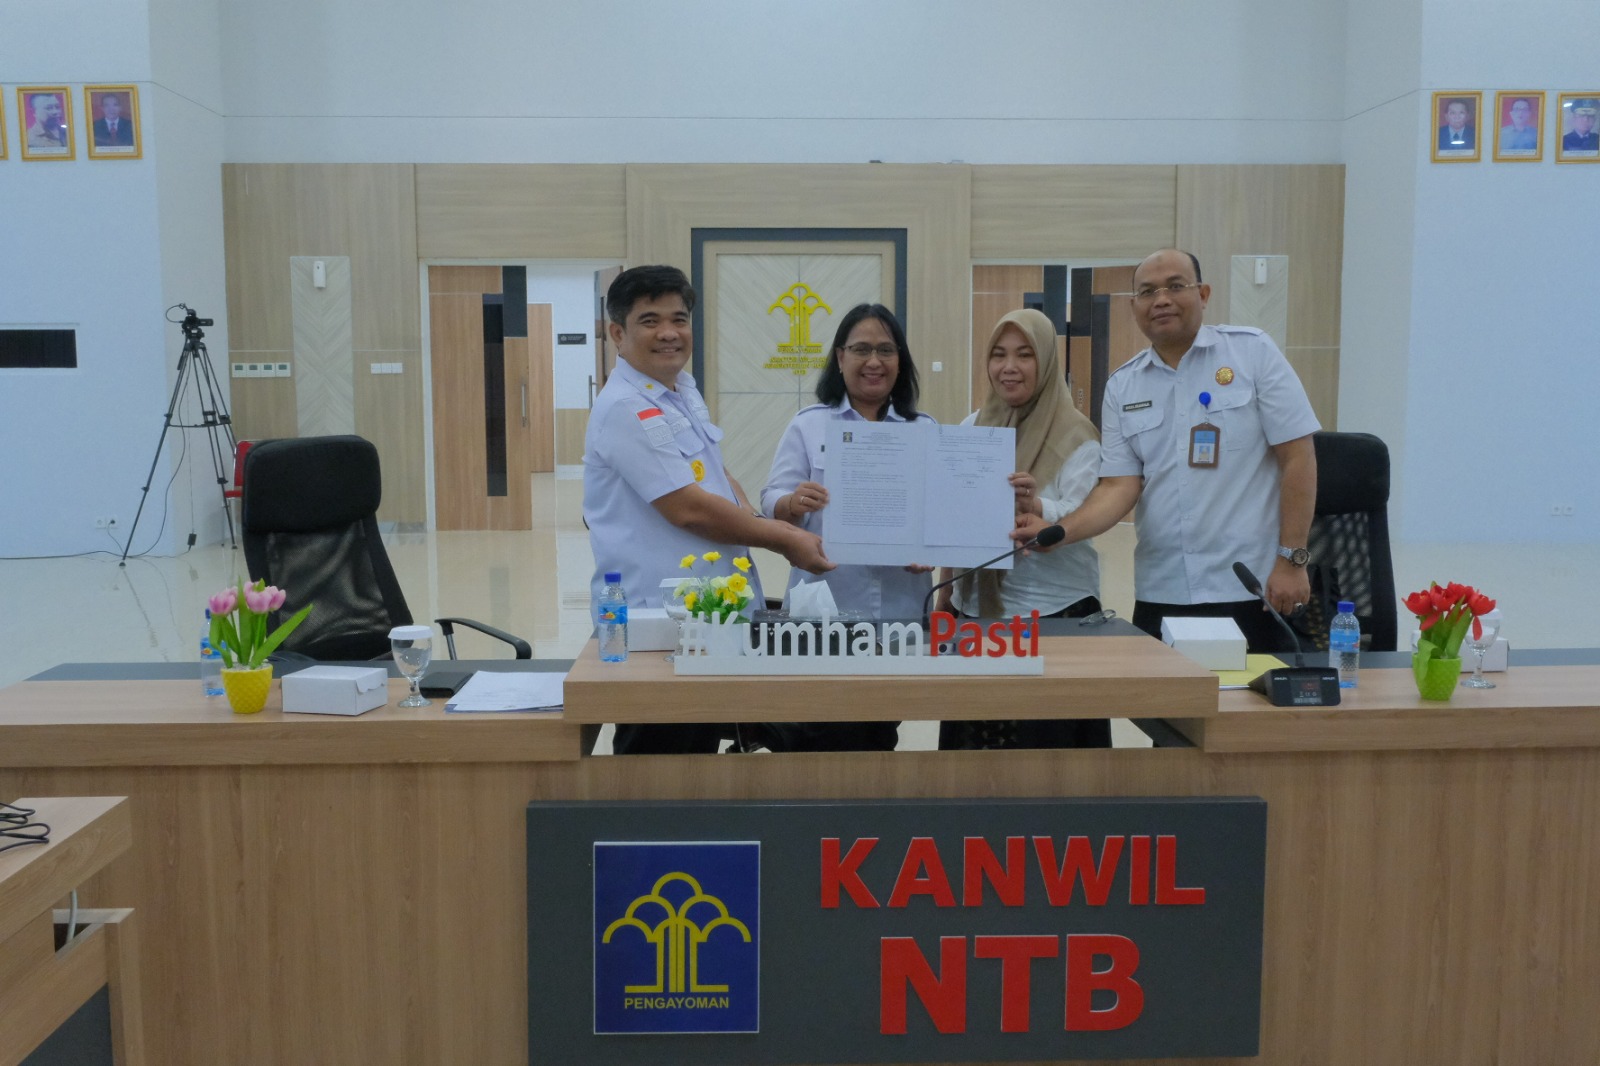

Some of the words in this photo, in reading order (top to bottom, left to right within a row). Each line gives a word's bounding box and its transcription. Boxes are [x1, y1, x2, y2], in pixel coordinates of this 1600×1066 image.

[820, 835, 1206, 909] KANWIL
[624, 997, 730, 1010] PENGAYOMAN
[880, 934, 1145, 1035] NTB
